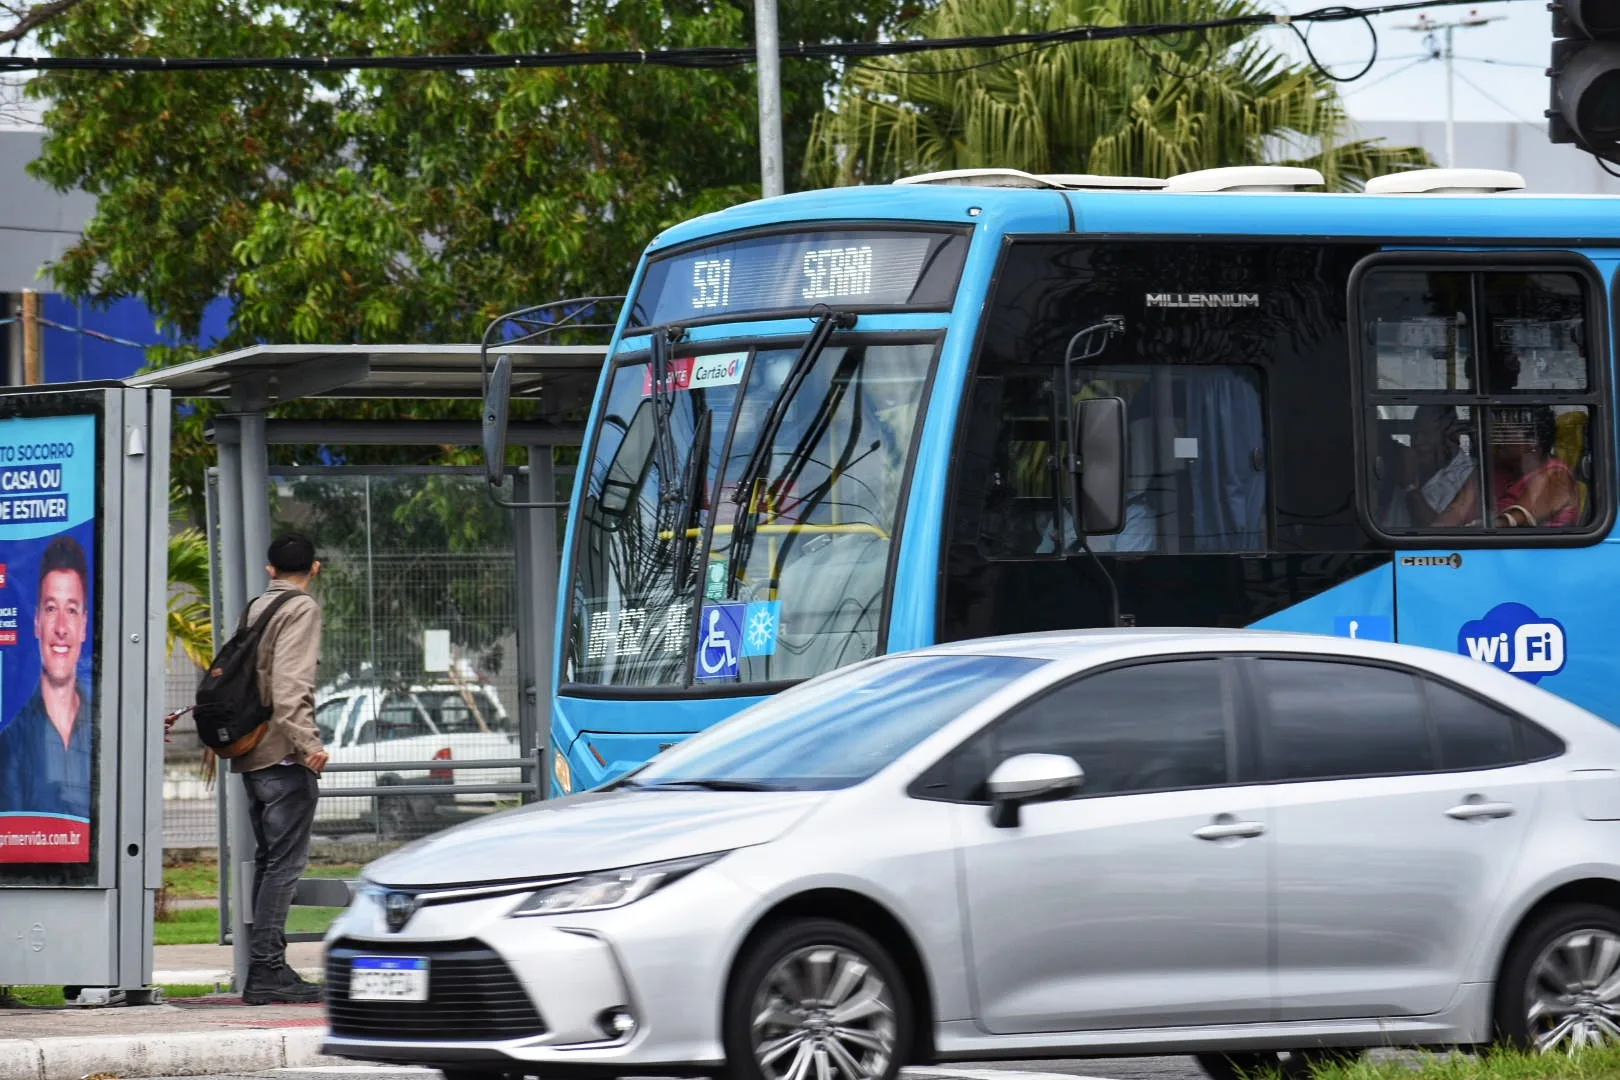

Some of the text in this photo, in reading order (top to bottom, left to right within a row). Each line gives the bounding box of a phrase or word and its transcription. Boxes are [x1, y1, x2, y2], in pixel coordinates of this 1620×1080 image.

[692, 246, 872, 309] 591 SERRA
[1146, 293, 1260, 308] MILLENNIUM
[695, 364, 727, 381] Cartão
[17, 442, 74, 461] SOCORRO
[2, 468, 60, 491] CASA OU
[13, 498, 66, 519] ESTIVER
